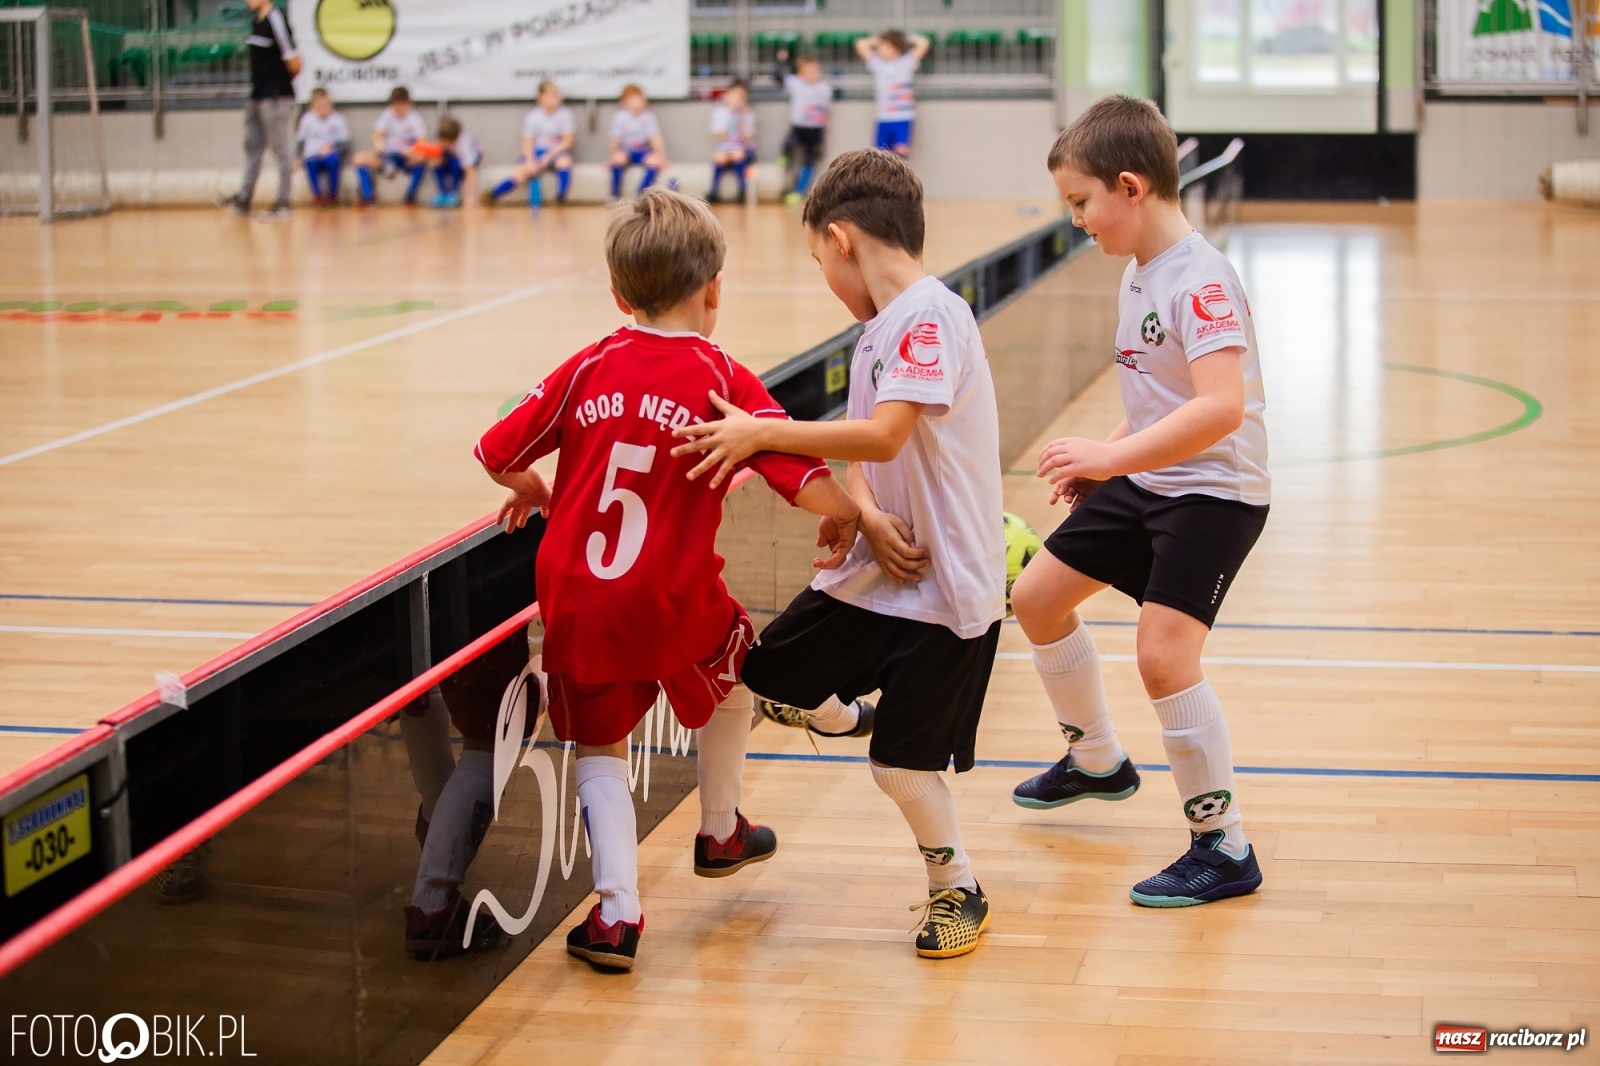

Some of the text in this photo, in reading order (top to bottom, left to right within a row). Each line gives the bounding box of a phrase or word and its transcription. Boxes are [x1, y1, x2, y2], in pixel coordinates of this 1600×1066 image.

[1196, 320, 1240, 336] AKADEMIA
[892, 365, 944, 377] AKADEMIA
[575, 392, 624, 428] 1908
[586, 441, 657, 580] 5
[1210, 573, 1224, 604] KIPSTA
